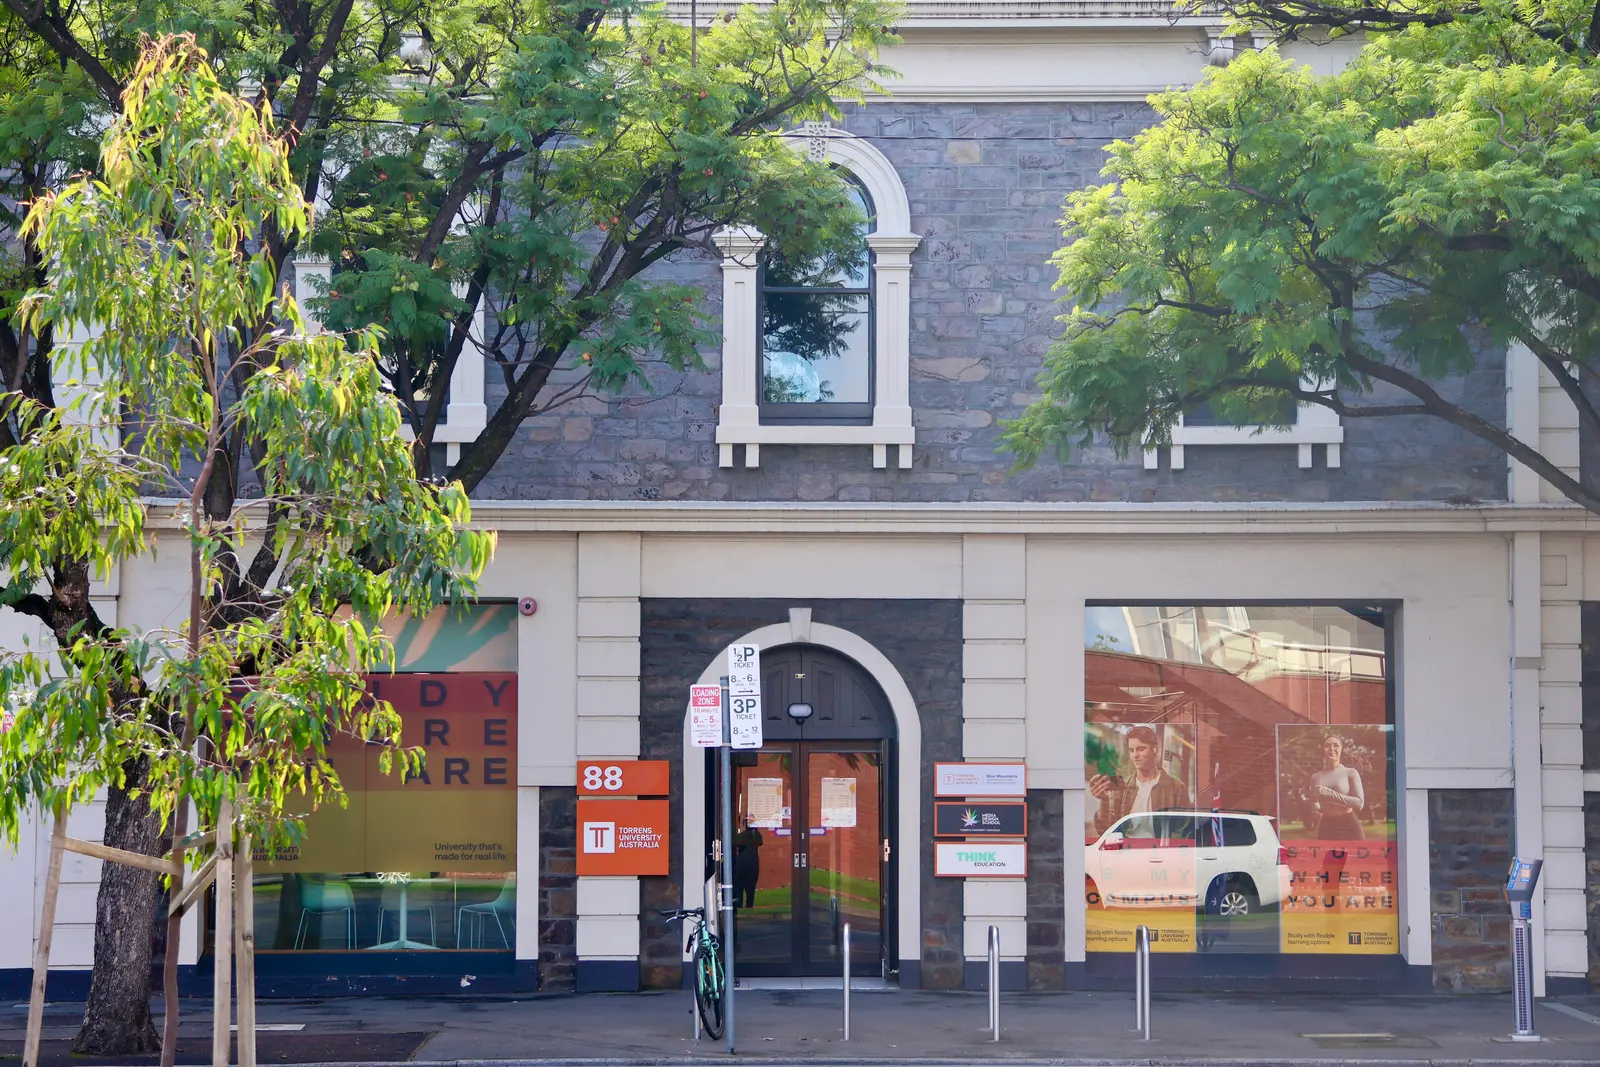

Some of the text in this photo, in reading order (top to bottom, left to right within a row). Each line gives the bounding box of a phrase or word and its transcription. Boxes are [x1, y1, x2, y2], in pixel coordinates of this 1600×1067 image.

[692, 688, 719, 697] LOADING
[697, 697, 715, 706] ZONE
[733, 698, 757, 714] 3P
[583, 765, 623, 791] 88
[434, 842, 503, 852] University that's
[1286, 846, 1393, 859] STUDY
[434, 852, 508, 861] made for real life.
[956, 852, 997, 862] THINK
[1288, 871, 1393, 883] WHERE
[1086, 892, 1191, 905] CAMPUS
[1288, 895, 1393, 908] YOU ARE
